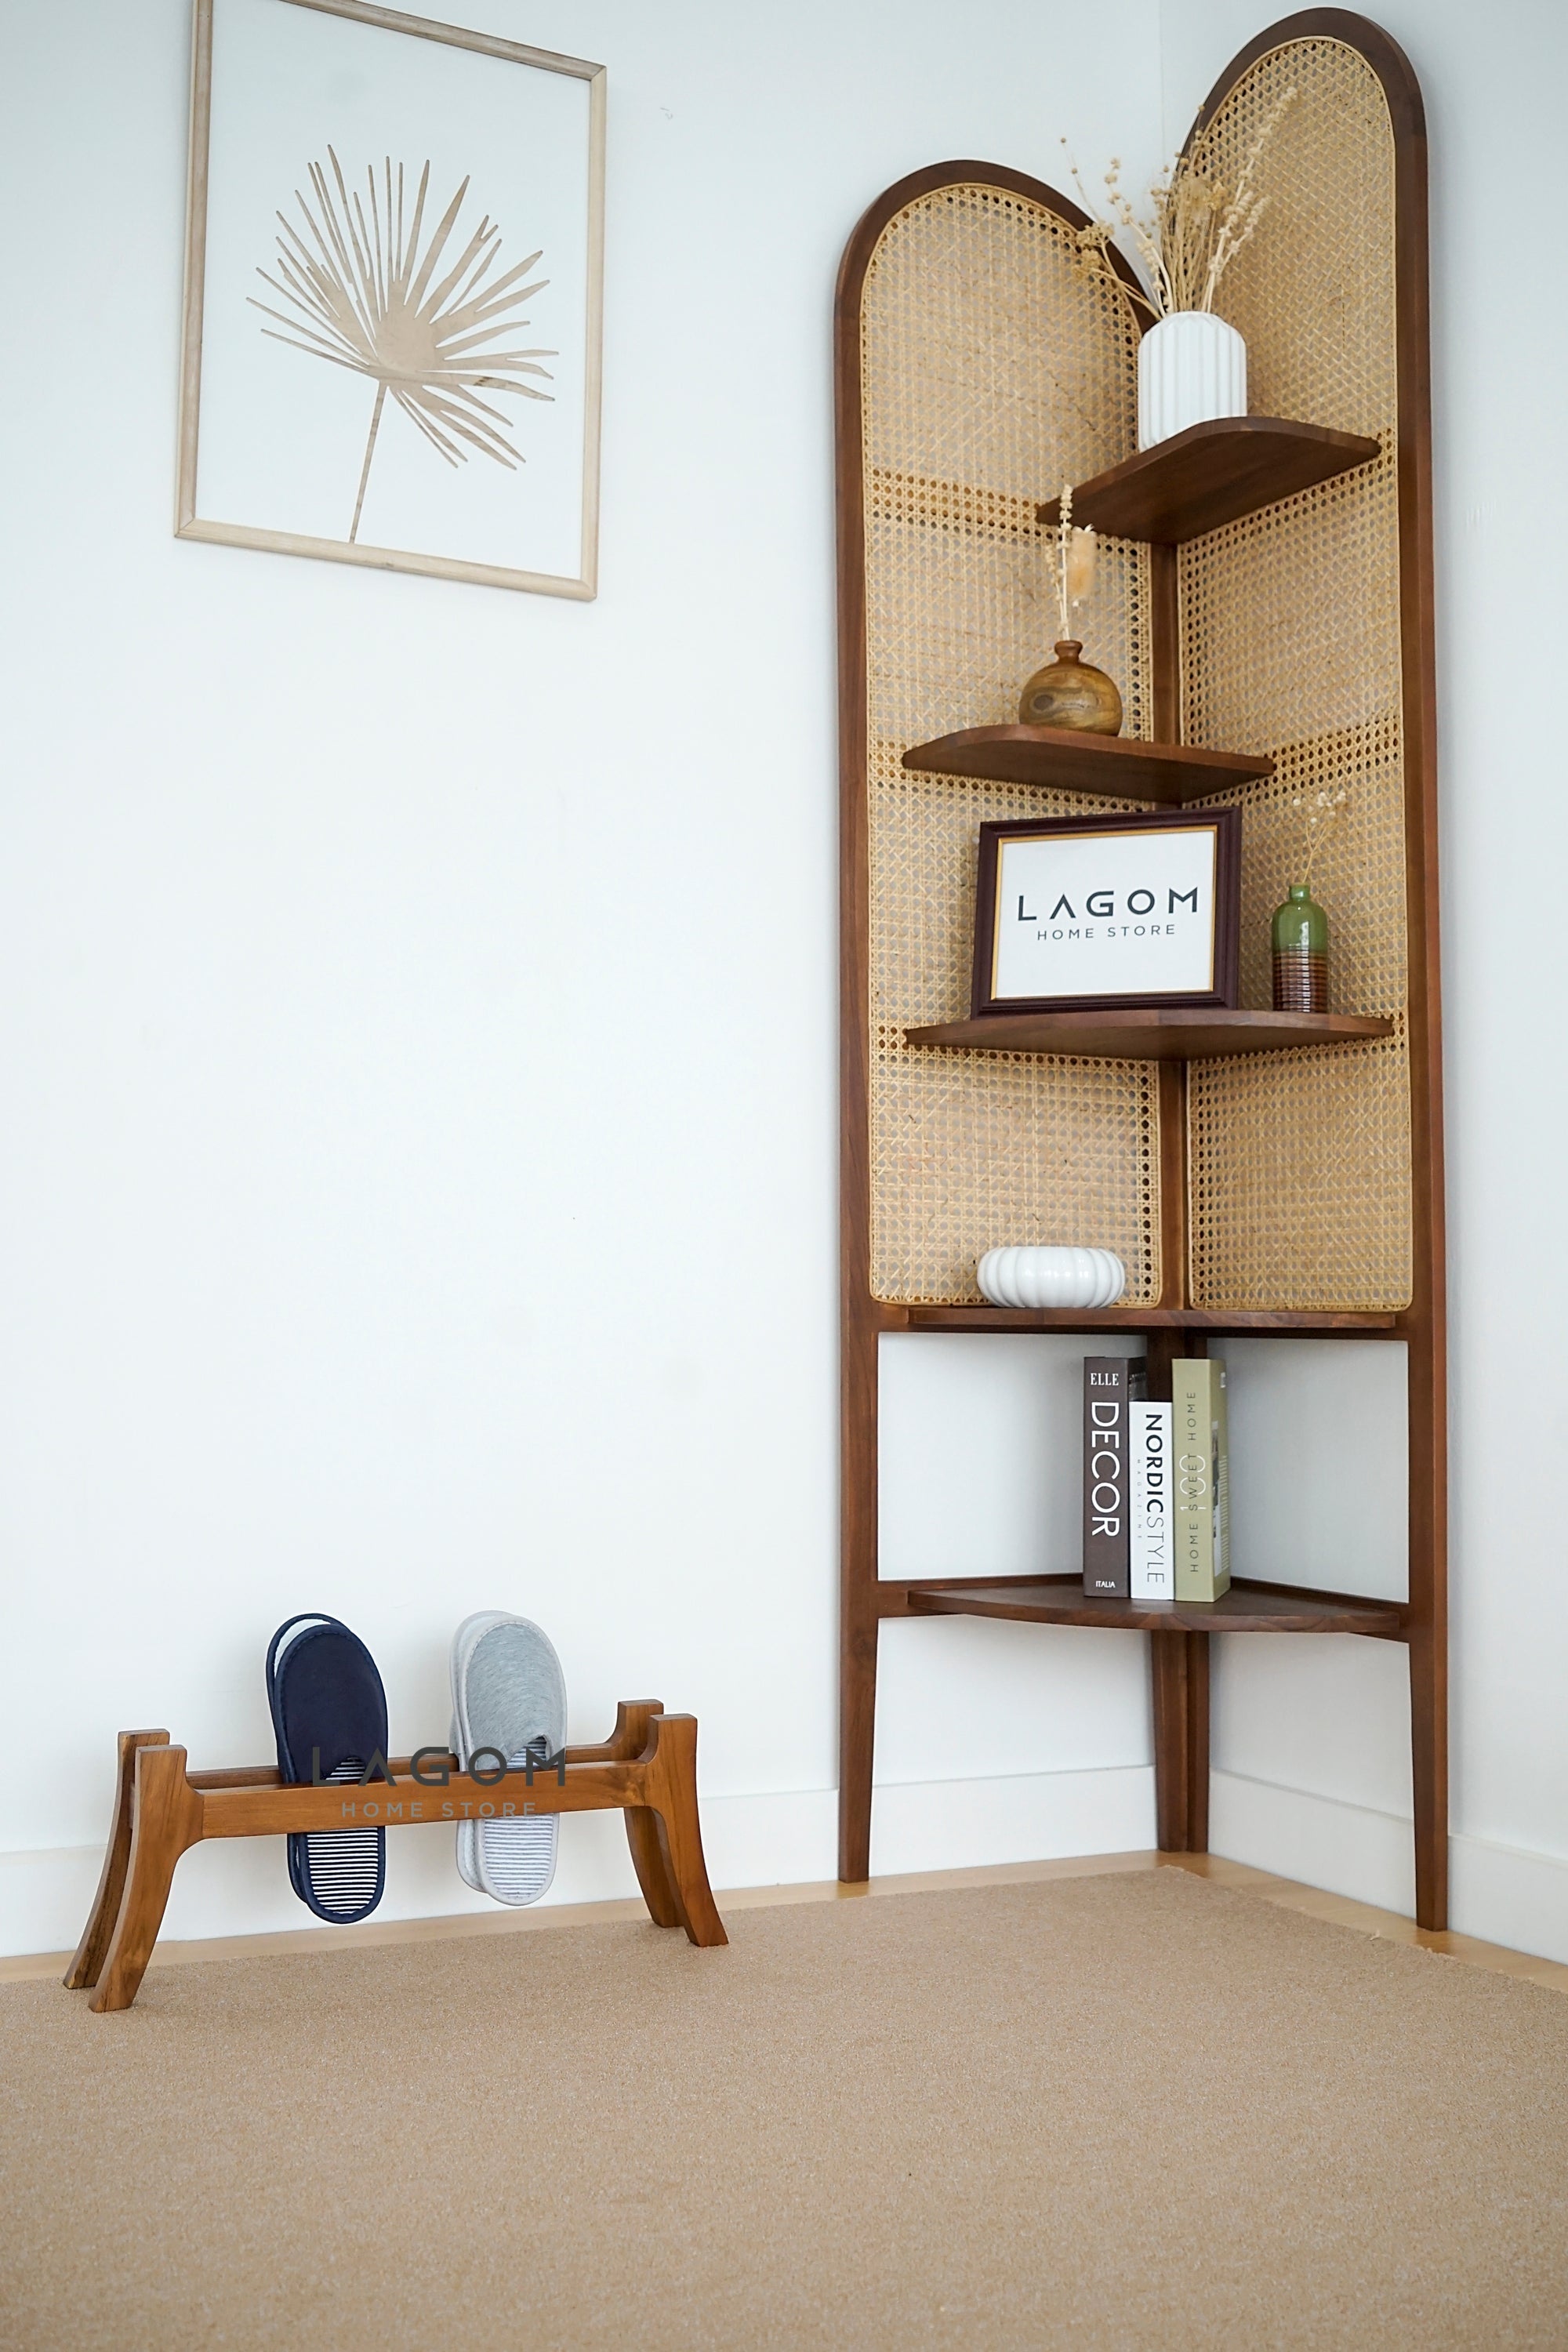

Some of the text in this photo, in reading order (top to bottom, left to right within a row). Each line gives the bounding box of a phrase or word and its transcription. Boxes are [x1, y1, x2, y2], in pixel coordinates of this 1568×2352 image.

[1018, 887, 1198, 921] LAGOM
[1037, 924, 1175, 941] HOME STORE
[1090, 1373, 1120, 1386] ELLE
[1091, 1402, 1120, 1537] DECOR
[1186, 1392, 1199, 1573] HOME SWEET HOME
